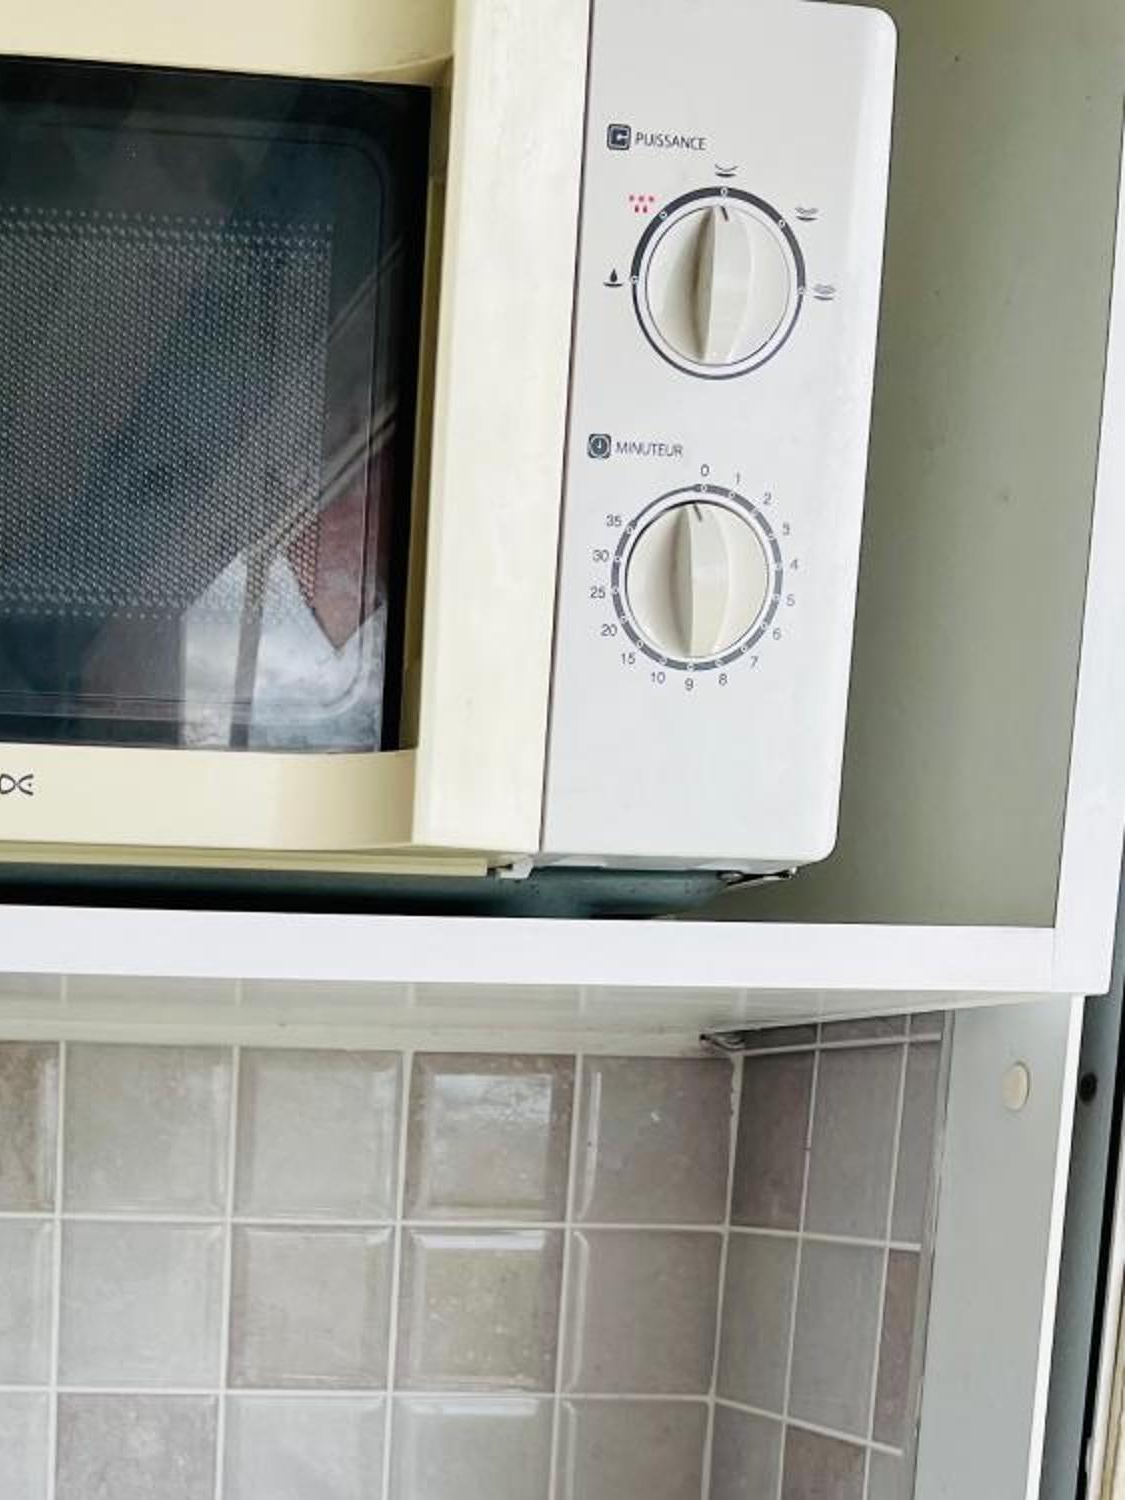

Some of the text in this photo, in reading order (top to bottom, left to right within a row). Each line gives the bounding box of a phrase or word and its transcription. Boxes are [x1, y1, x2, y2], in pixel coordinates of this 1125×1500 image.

[635, 132, 705, 150] PUISSANCE
[616, 442, 683, 457] MINUTEUR
[700, 464, 709, 477] 0
[735, 472, 741, 484] 1
[763, 492, 771, 505] 2
[607, 514, 622, 527] 35
[593, 550, 609, 562] 30
[790, 559, 798, 570] 4
[591, 586, 605, 598] 25
[601, 624, 617, 637] 20
[621, 652, 635, 664] 15
[751, 656, 758, 667] 7
[651, 672, 665, 684] 10
[685, 678, 693, 691] 9
[719, 673, 727, 686] 8
